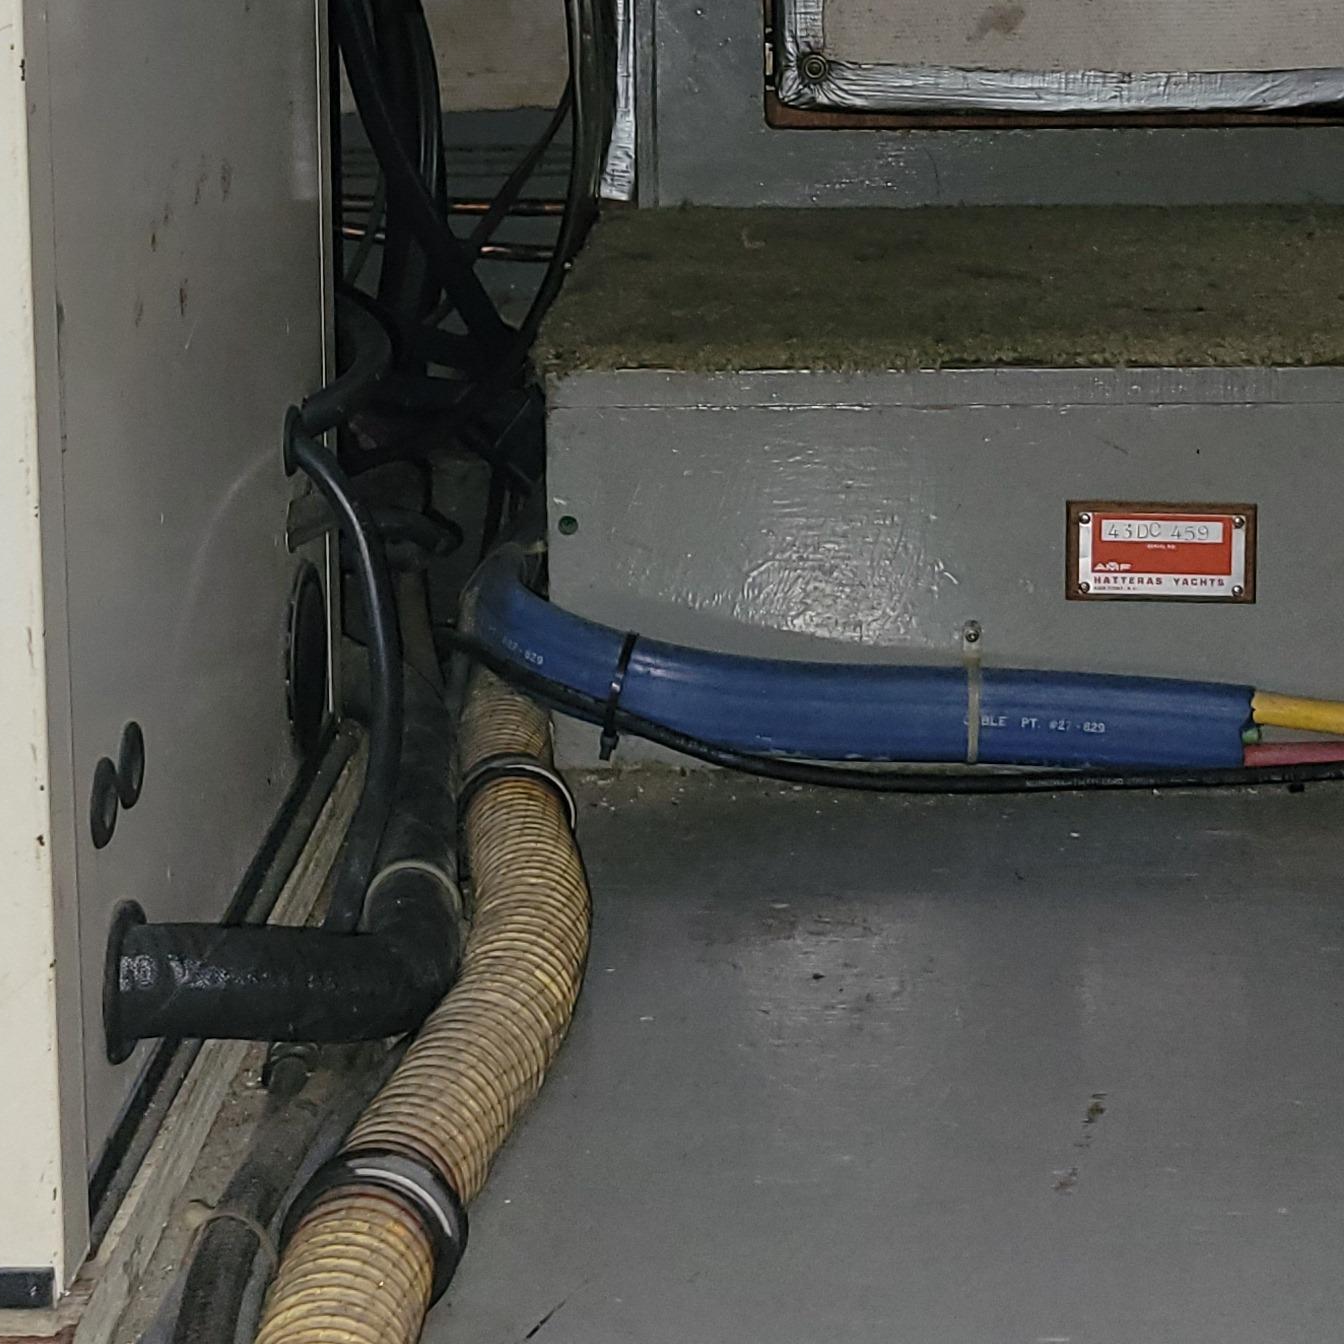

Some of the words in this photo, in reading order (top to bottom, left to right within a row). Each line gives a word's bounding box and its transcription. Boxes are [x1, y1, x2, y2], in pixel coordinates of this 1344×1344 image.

[1094, 562, 1132, 571] AMF
[1094, 576, 1163, 586] HATTERAS
[1173, 578, 1225, 588] YACHTS
